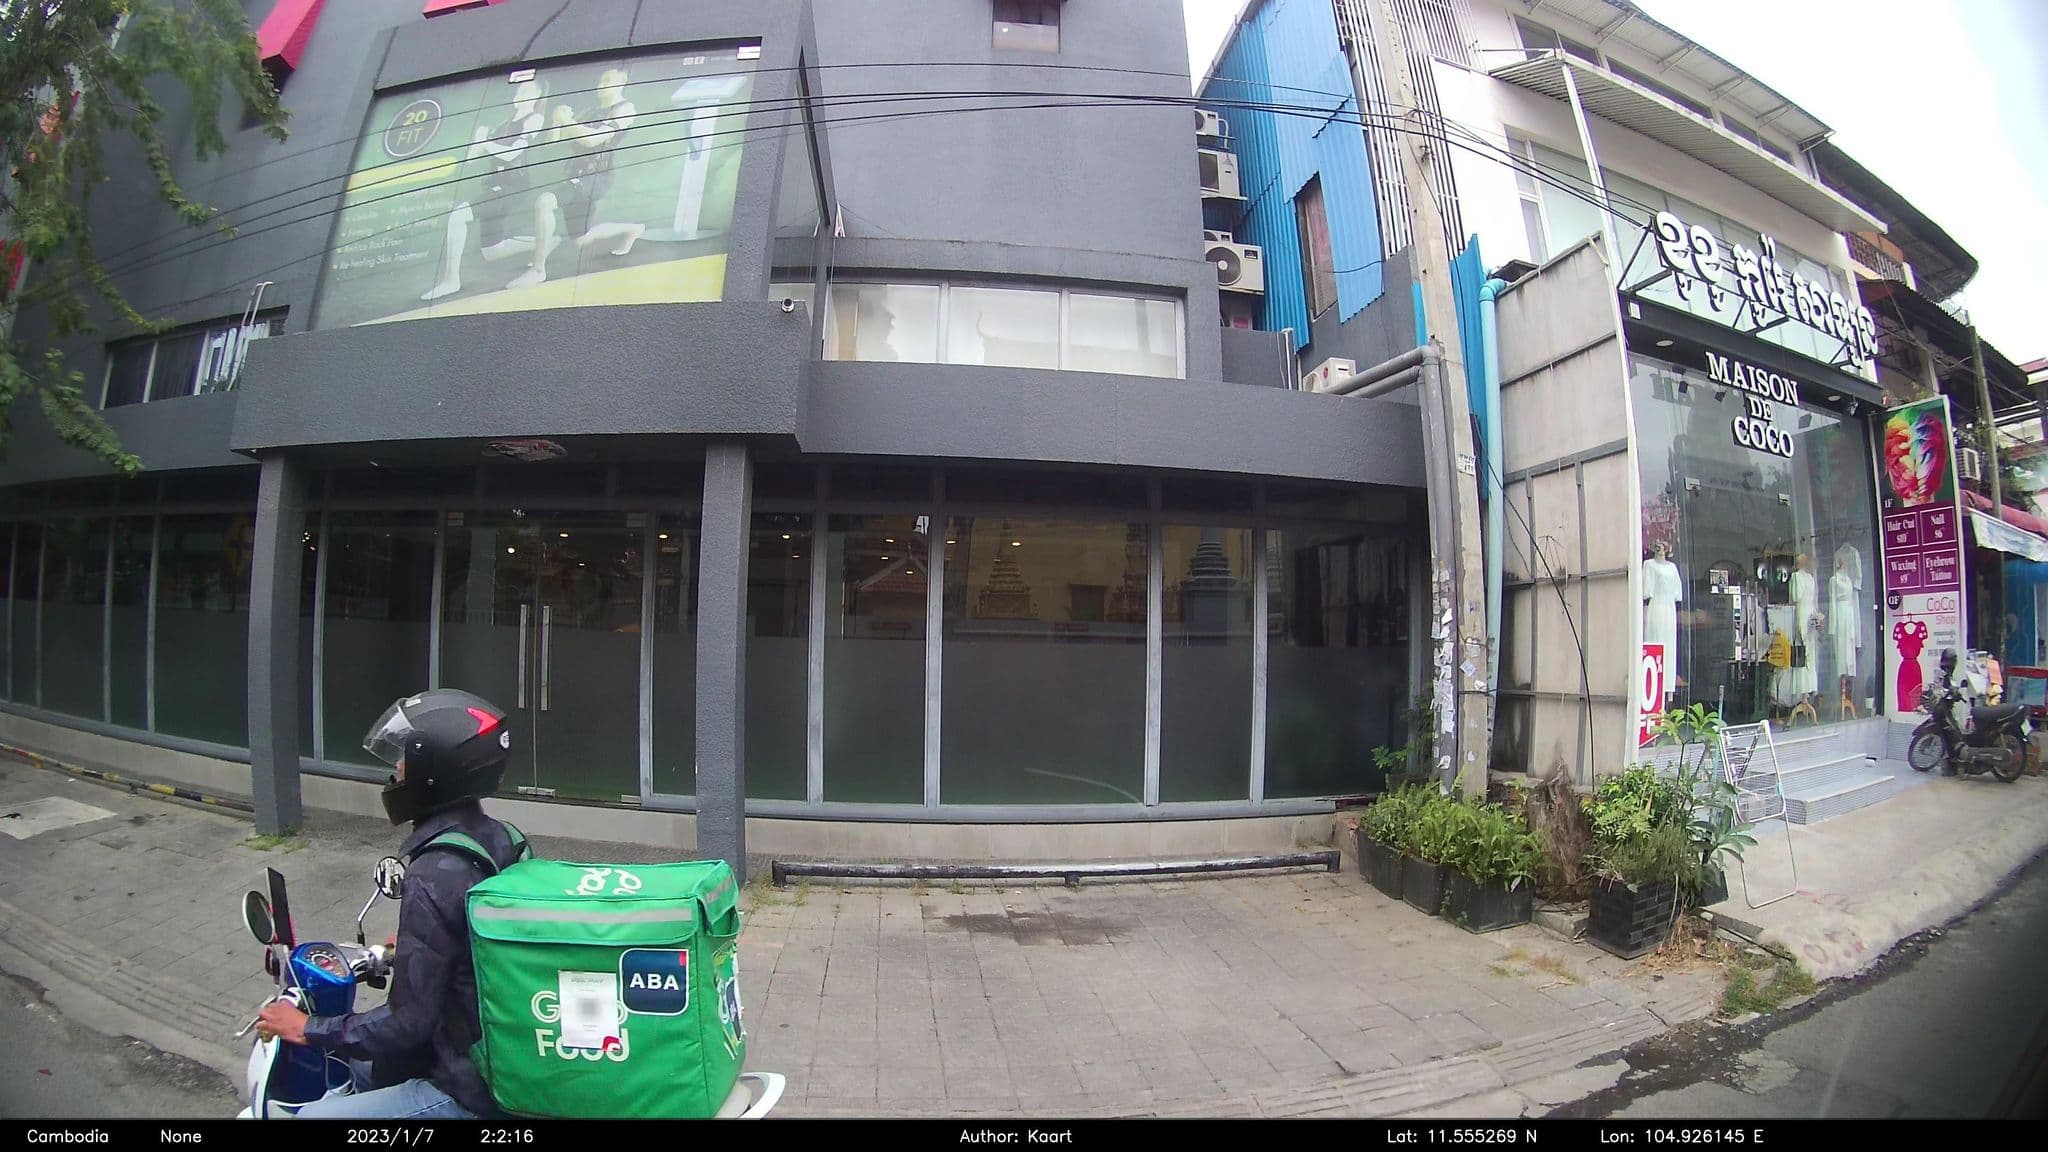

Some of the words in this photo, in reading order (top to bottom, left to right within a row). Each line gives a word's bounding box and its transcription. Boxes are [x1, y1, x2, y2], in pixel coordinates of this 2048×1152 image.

[403, 110, 427, 126] 20
[396, 127, 424, 147] FIT
[1705, 351, 1799, 406] MAISON
[1748, 396, 1774, 421] DE
[1734, 416, 1794, 458] COCO
[1887, 521, 1901, 532] Hair
[1902, 519, 1915, 529] Cut
[1930, 513, 1945, 525] Nail
[1891, 559, 1917, 573] Waxing
[1925, 556, 1956, 571] Eyebrow
[1930, 571, 1952, 581] Tattoo
[1888, 596, 1900, 605] GF
[629, 973, 680, 991] ABA
